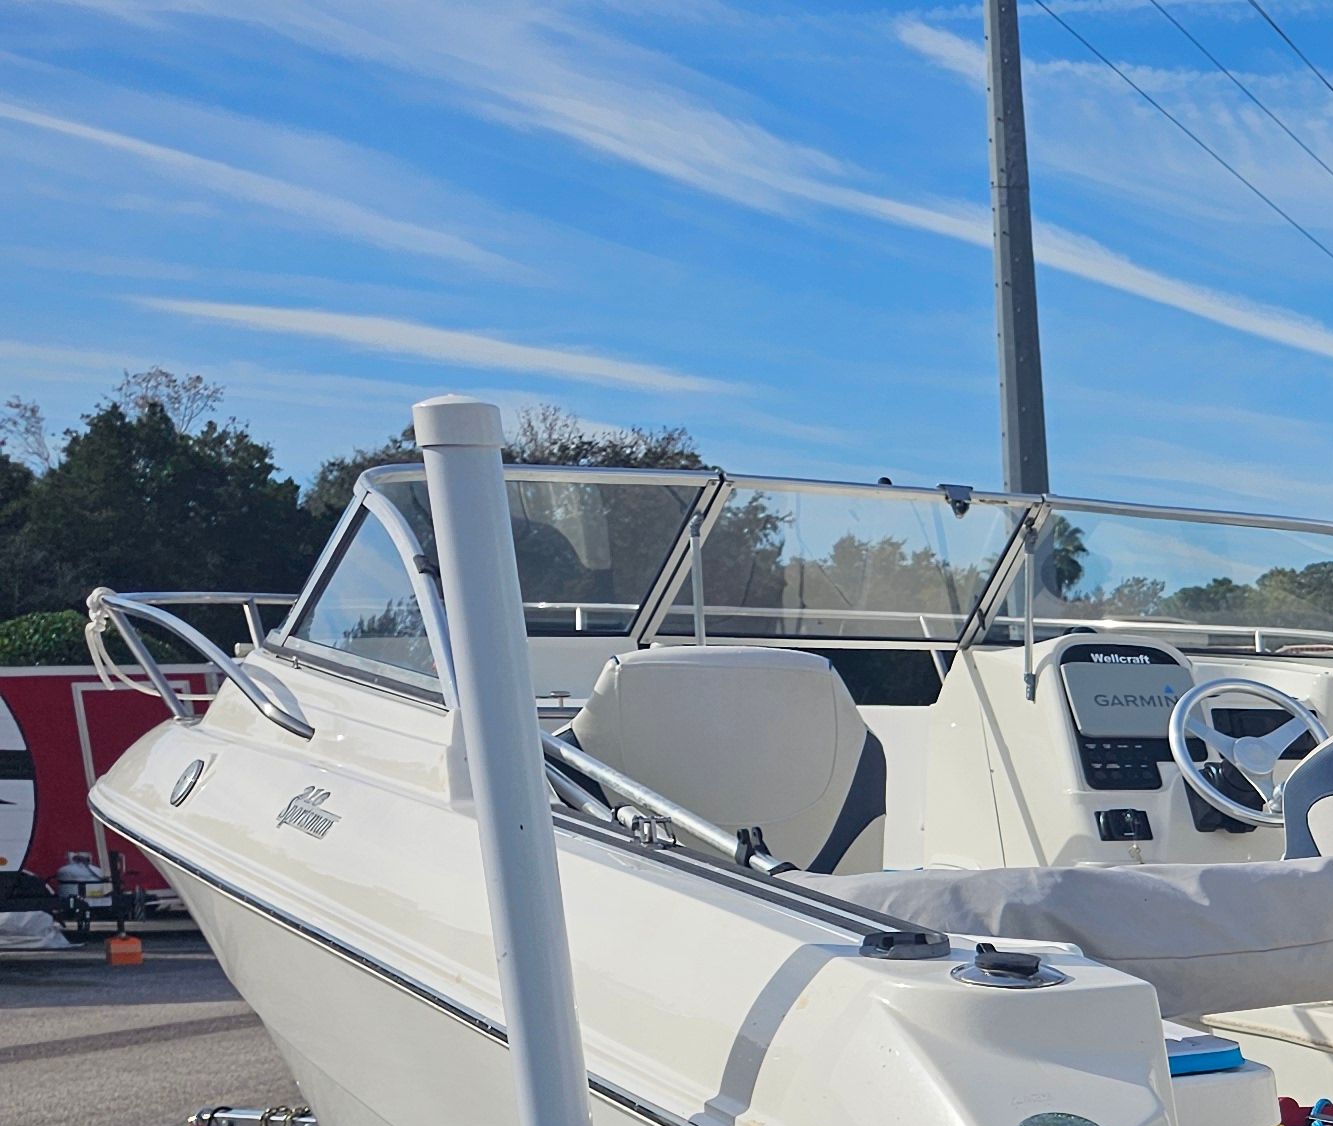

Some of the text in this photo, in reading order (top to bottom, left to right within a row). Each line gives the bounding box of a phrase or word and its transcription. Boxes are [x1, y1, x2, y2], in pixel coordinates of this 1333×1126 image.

[1090, 652, 1151, 665] Wellcraft
[1093, 694, 1178, 708] GARMIN
[276, 795, 338, 839] Sportsman
